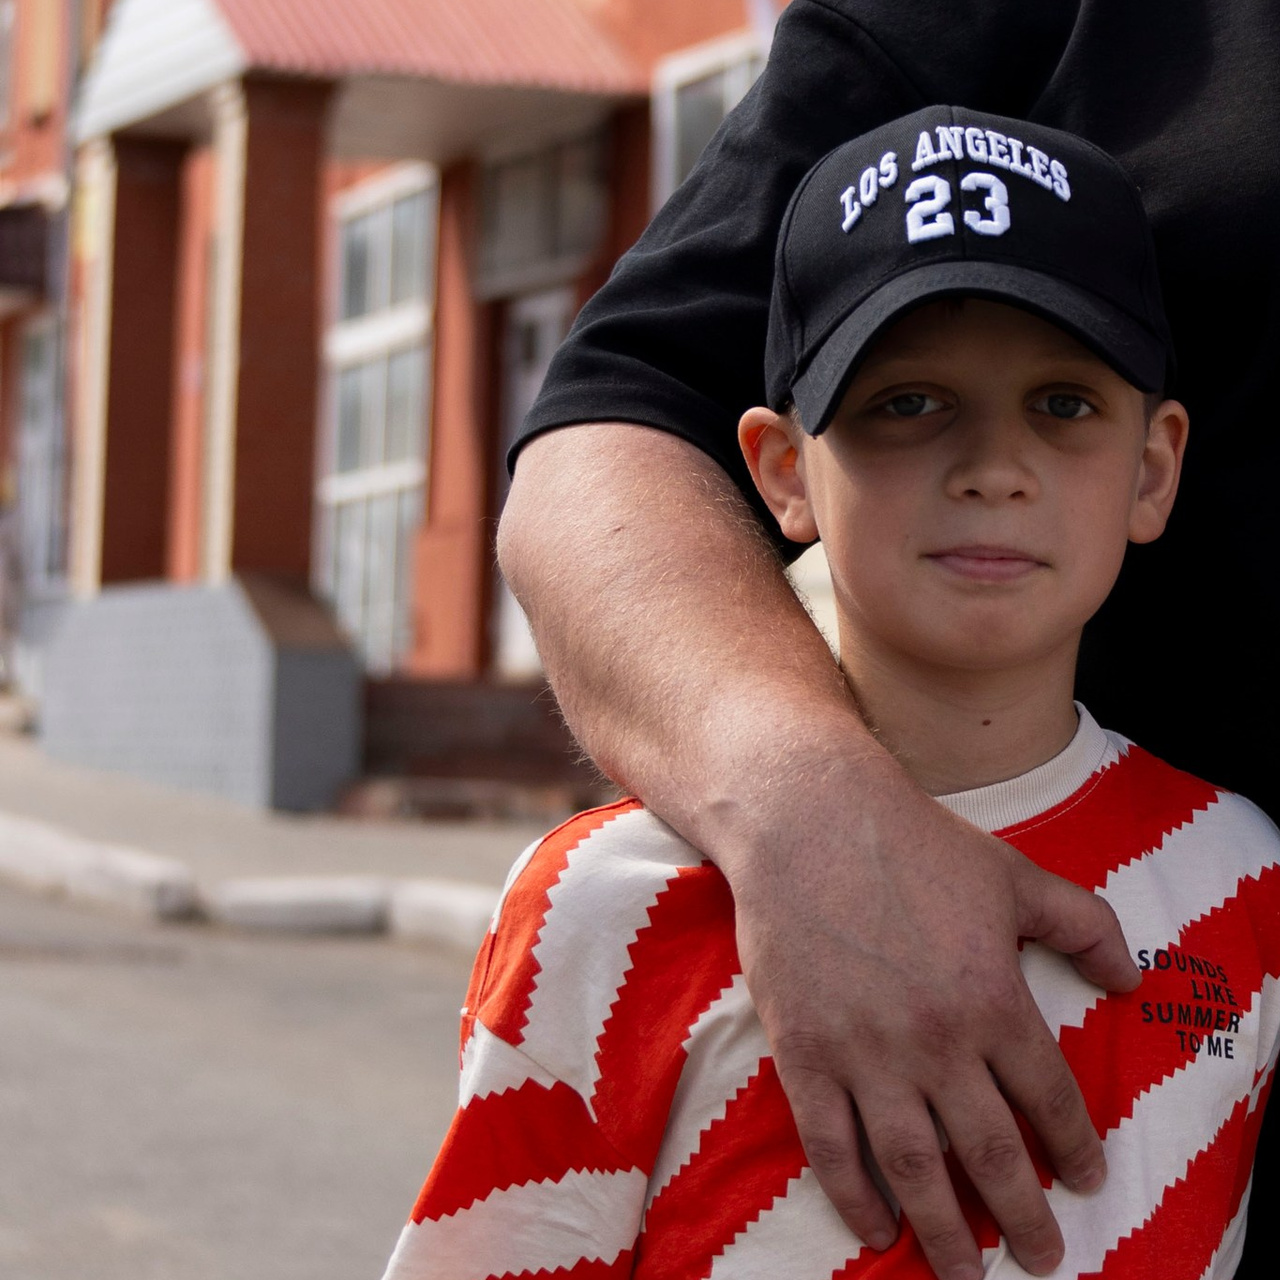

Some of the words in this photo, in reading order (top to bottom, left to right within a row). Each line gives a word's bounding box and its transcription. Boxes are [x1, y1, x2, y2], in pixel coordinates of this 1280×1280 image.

[840, 151, 898, 233] LOS
[911, 126, 1071, 202] ANGELES
[904, 172, 1011, 244] 23
[1137, 948, 1228, 984] SOUNDS
[1190, 979, 1238, 1007] LIKE
[1141, 1001, 1241, 1034] SUMMER
[1176, 1030, 1201, 1054] TO
[1207, 1036, 1235, 1059] ME
